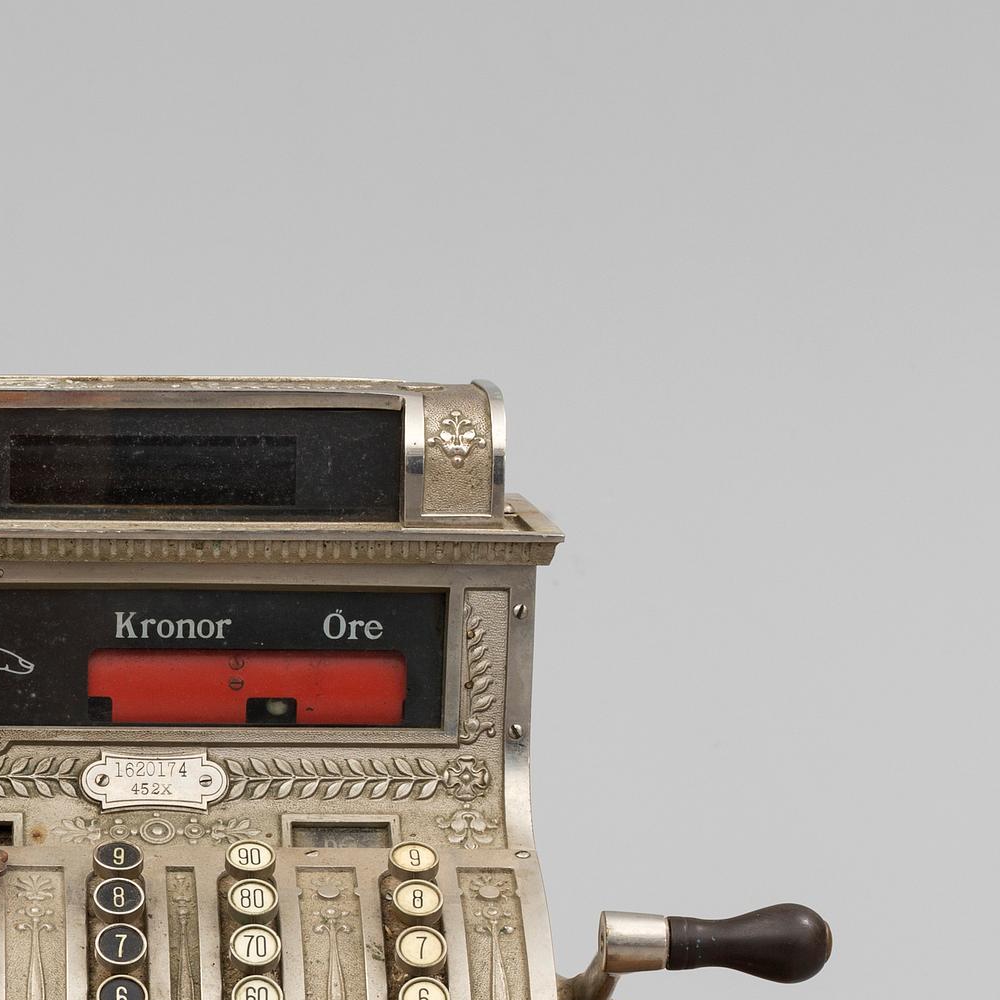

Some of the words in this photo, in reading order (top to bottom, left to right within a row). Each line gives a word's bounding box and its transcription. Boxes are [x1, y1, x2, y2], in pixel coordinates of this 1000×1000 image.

[114, 610, 232, 640] Kronor
[322, 608, 384, 640] Öre
[114, 761, 188, 778] 1620174
[130, 782, 174, 795] 452X
[113, 847, 125, 865] 9
[237, 847, 261, 865] 90
[409, 849, 421, 867] 9
[113, 886, 125, 908] 8
[240, 888, 264, 909] 80
[412, 889, 424, 909] 8
[115, 934, 128, 958] 7
[243, 934, 267, 958] 70
[415, 936, 428, 960] 7
